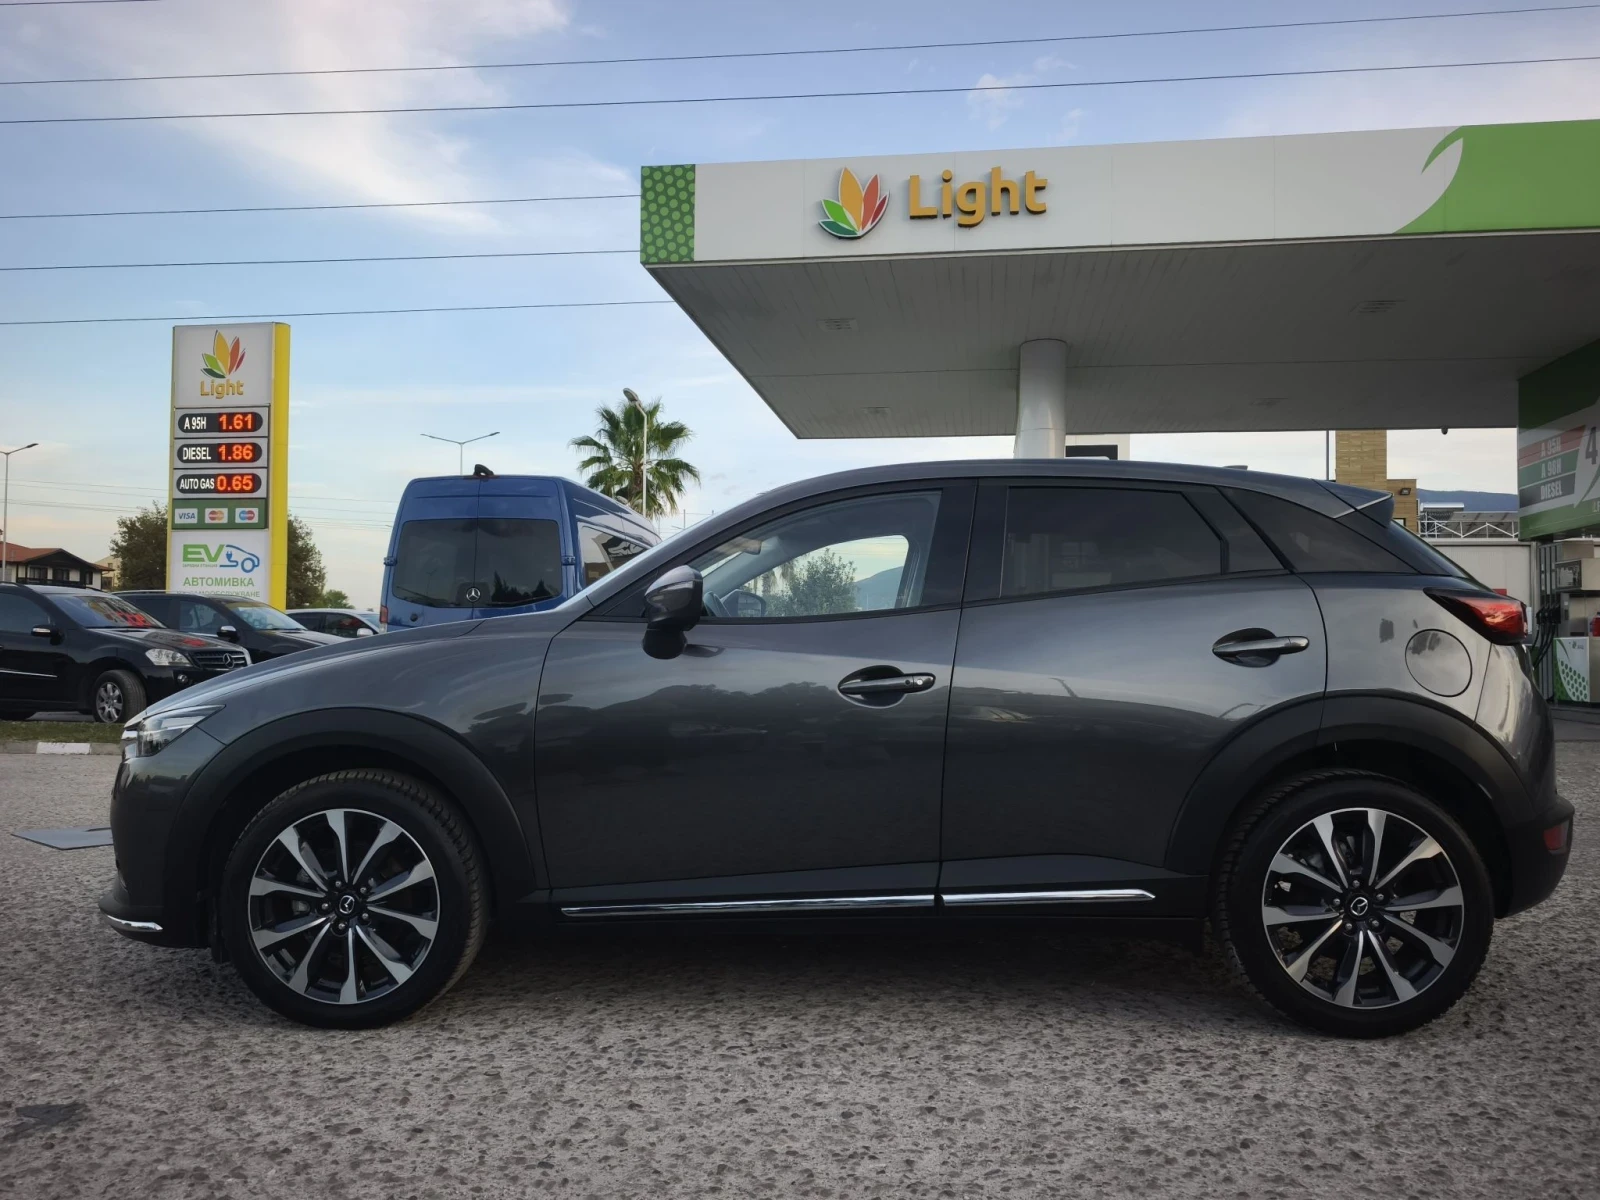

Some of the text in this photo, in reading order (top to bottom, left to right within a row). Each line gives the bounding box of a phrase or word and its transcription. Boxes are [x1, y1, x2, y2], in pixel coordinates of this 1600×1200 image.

[909, 166, 1048, 228] Light
[200, 379, 245, 400] Light
[183, 416, 191, 430] A
[219, 413, 253, 430] 1.61
[182, 444, 253, 461] DIESEL 1.86
[1585, 426, 1598, 465] 4
[179, 474, 253, 491] AUTO GAS 0.65
[1540, 480, 1563, 500] DIESEL
[178, 512, 196, 520] VISA
[182, 543, 225, 563] EV
[183, 577, 255, 587] АВТОМИВКА
